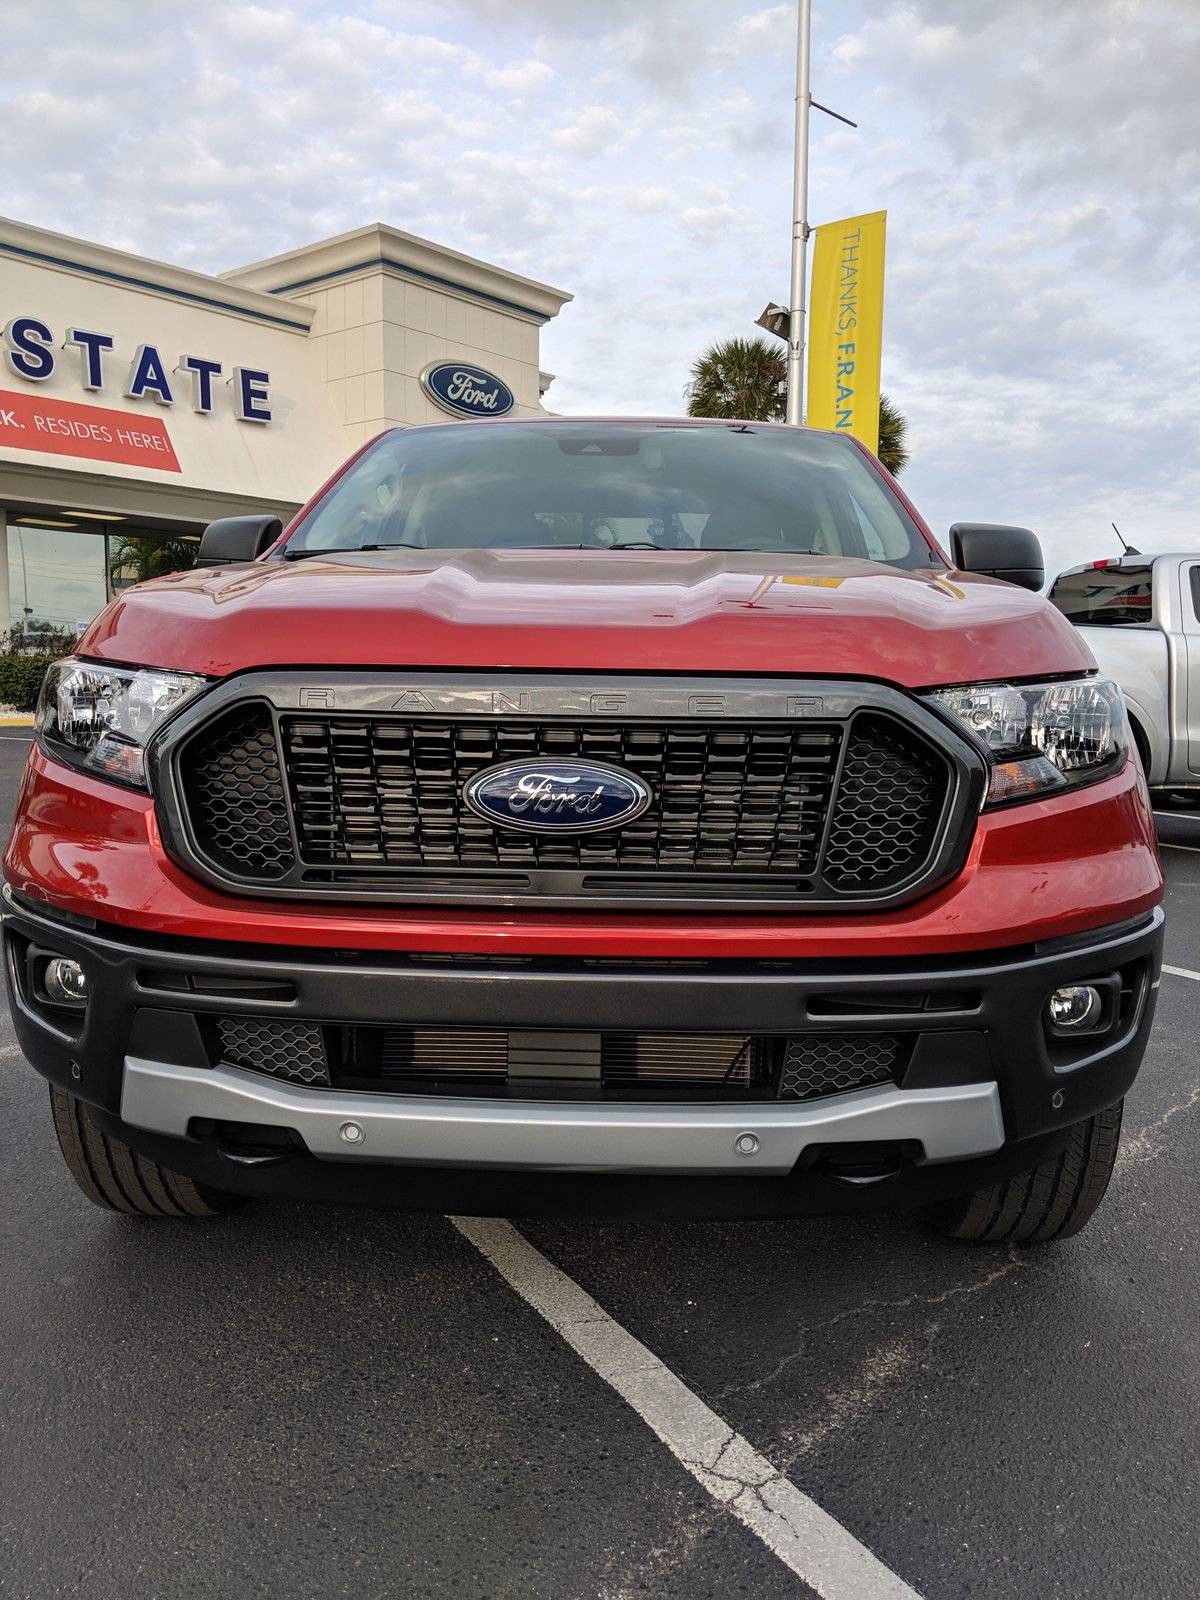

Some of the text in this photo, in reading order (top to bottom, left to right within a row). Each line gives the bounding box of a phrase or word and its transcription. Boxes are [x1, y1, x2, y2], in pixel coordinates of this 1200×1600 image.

[836, 227, 861, 336] THANKS,
[6, 317, 272, 422] STATE
[447, 371, 499, 409] Ford
[34, 415, 112, 442] RESIDES
[118, 430, 170, 453] HERE!
[299, 687, 824, 717] RANGER
[508, 773, 604, 814] Ford
